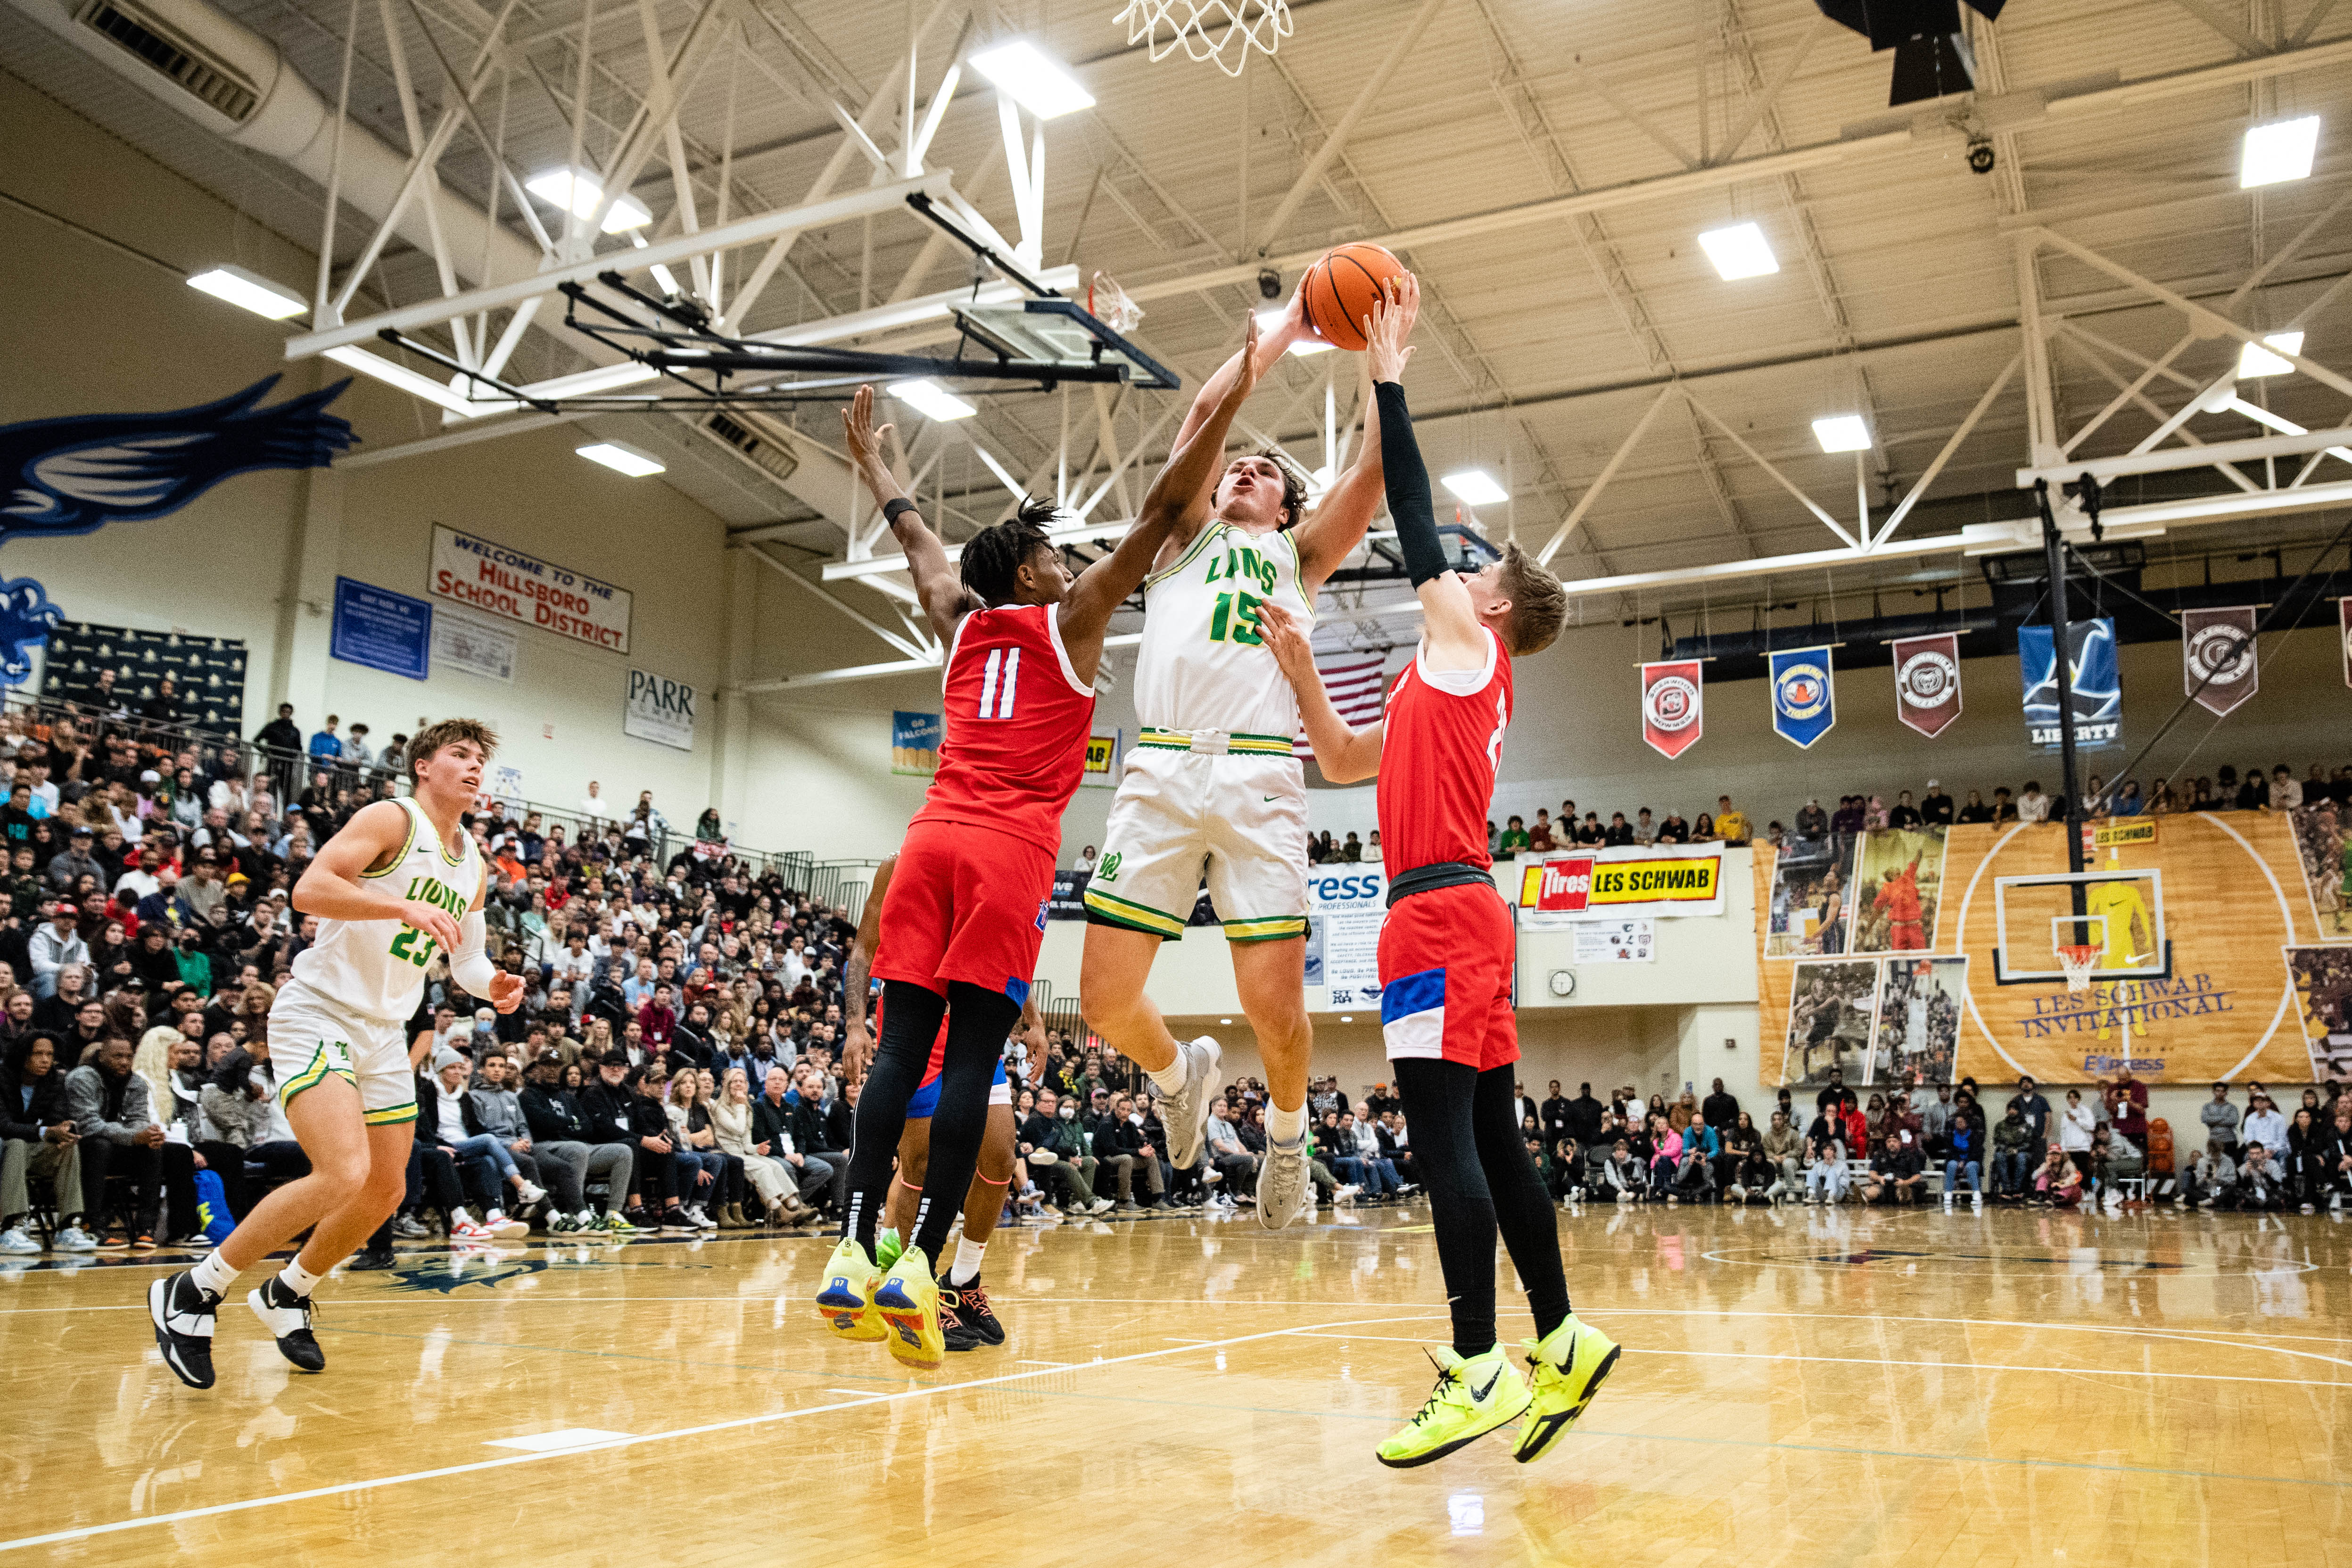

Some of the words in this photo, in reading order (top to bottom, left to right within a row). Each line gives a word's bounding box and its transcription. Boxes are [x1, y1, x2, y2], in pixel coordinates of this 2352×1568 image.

[454, 535, 543, 576] WELCOME
[553, 570, 575, 586] TO
[584, 580, 613, 599] THE
[479, 560, 589, 615] HILLSBORO
[438, 569, 522, 617] SCHOOL
[535, 602, 622, 647] DISTRICT
[1209, 589, 1263, 647] 15
[630, 670, 694, 717] PARR
[978, 647, 1021, 720] 11
[1649, 679, 1694, 698] SHERWOOD
[1654, 715, 1691, 728] BOWMEN
[2031, 723, 2118, 743] LIBRTY
[405, 877, 467, 922] LIONS
[1308, 875, 1380, 900] ress
[1543, 867, 1589, 899] Tires
[1595, 873, 1624, 892] LES
[1629, 868, 1709, 891] SCHWAB
[1318, 900, 1376, 911] PROFESSIONALS
[389, 920, 437, 968] 23
[2020, 992, 2234, 1038] INVITATIONAL
[2032, 992, 2084, 1015] LES
[2095, 973, 2212, 1007] SCHWAB
